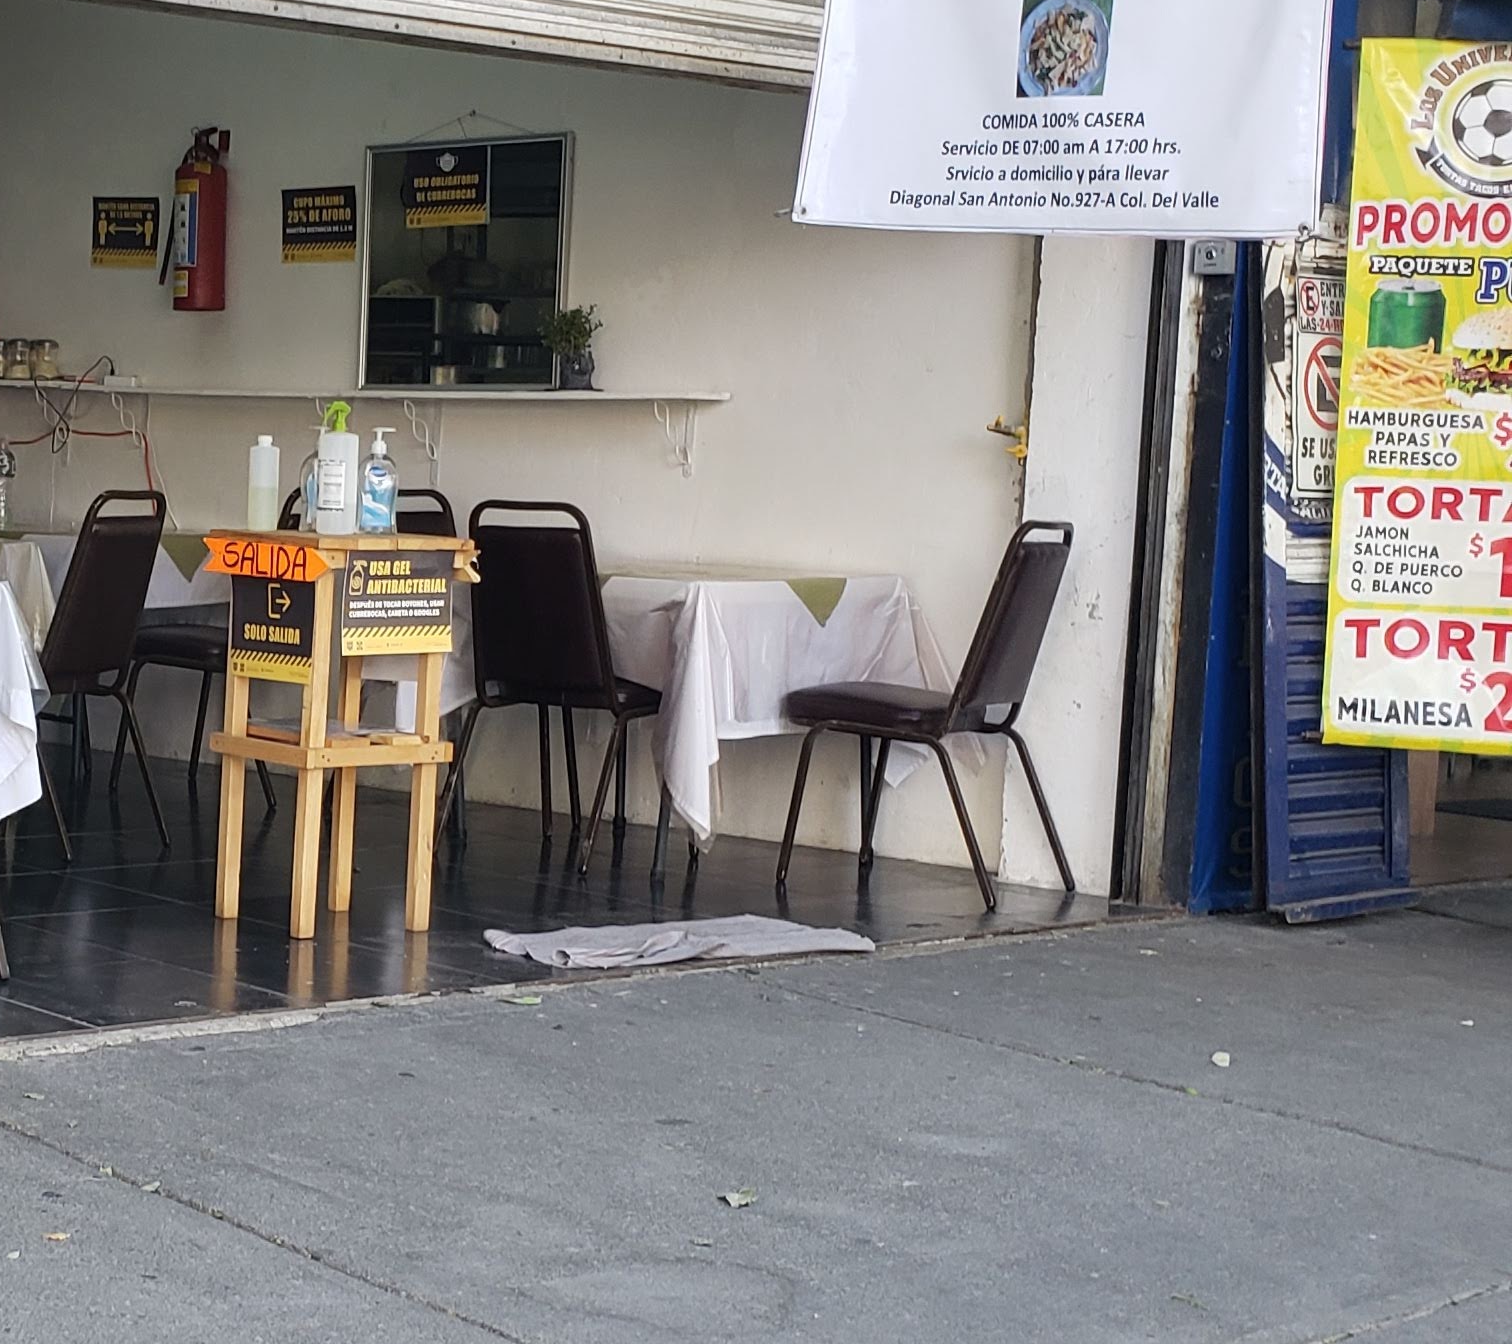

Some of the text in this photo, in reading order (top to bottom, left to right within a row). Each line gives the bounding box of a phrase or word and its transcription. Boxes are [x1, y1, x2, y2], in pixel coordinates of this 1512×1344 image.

[1430, 44, 1512, 87] UNIVE
[982, 112, 1145, 130] COMIDA 100% CASERA
[941, 138, 1182, 156] Servicio DE 07:00 am A 17:00 hrs.
[945, 164, 1170, 186] Srvicio a domicilio y pára llevar
[889, 190, 1219, 209] Diagonal San Antonio No.927-A Col. Del Valle
[1370, 256, 1473, 277] PAQUETE
[1348, 409, 1484, 430] HAMBURGUESA
[1301, 437, 1336, 460] SE US
[1375, 431, 1452, 448] PAPAS Y
[1368, 449, 1458, 467] REFRESCO
[1314, 464, 1335, 486] GR
[1354, 486, 1512, 523] TORT
[1356, 524, 1409, 541] JAMON
[1354, 542, 1439, 559] SALCHICHA
[223, 542, 306, 580] SALIDA
[369, 560, 411, 575] USA GEL
[1352, 560, 1463, 578] Q. DE PUERCO
[367, 578, 447, 594] ANTIBACTERIAL
[1351, 578, 1433, 595] Q. BLANCO
[244, 623, 300, 645] SOLO SALIDA
[1337, 696, 1473, 729] MILANESA
